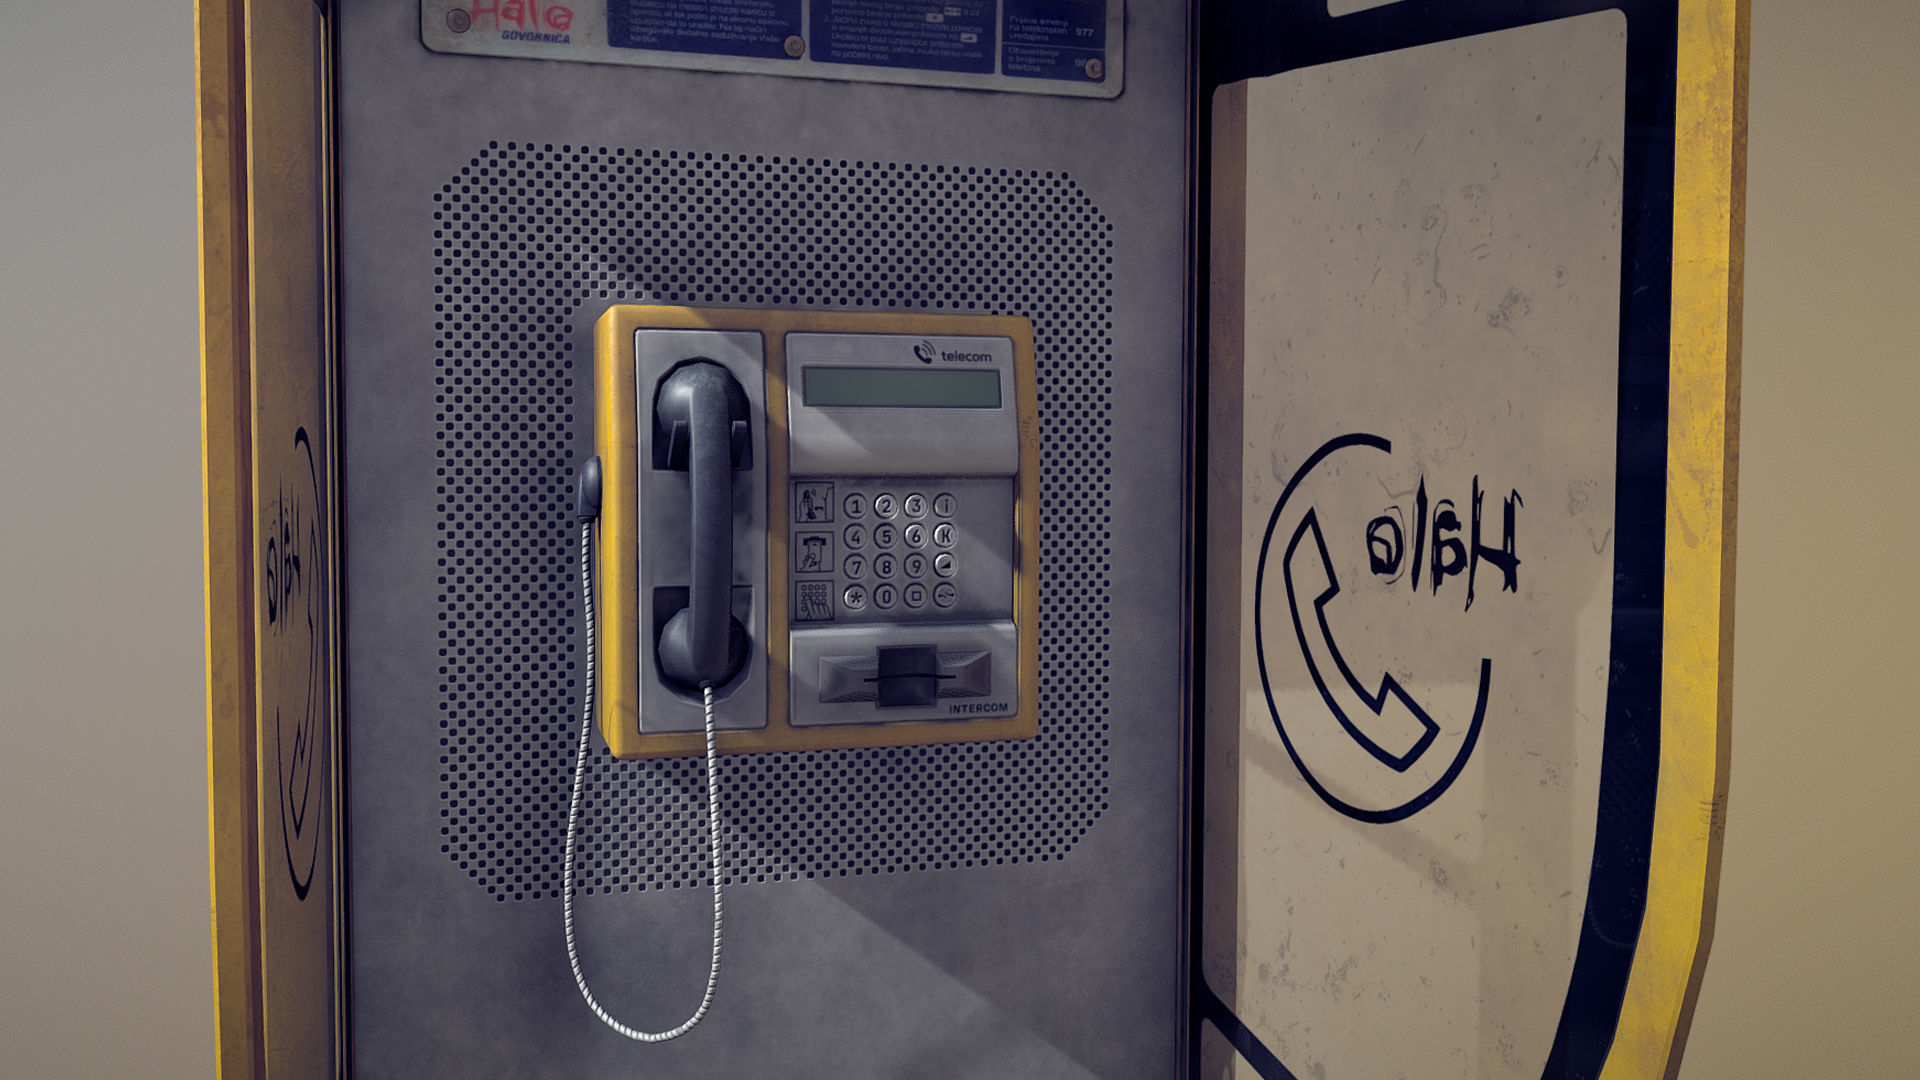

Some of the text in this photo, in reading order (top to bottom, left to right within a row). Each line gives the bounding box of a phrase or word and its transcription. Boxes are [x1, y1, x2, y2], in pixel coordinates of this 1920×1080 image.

[501, 30, 570, 44] GOVORNICA
[1075, 27, 1095, 37] 977
[941, 350, 993, 362] telecom
[852, 499, 862, 514] 1
[882, 499, 891, 513] 2
[912, 499, 921, 513] 3
[851, 529, 951, 544] 4 5 6 K
[852, 560, 921, 575] 7 8 9
[883, 590, 892, 604] 0
[949, 702, 1008, 714] INTERCOM
